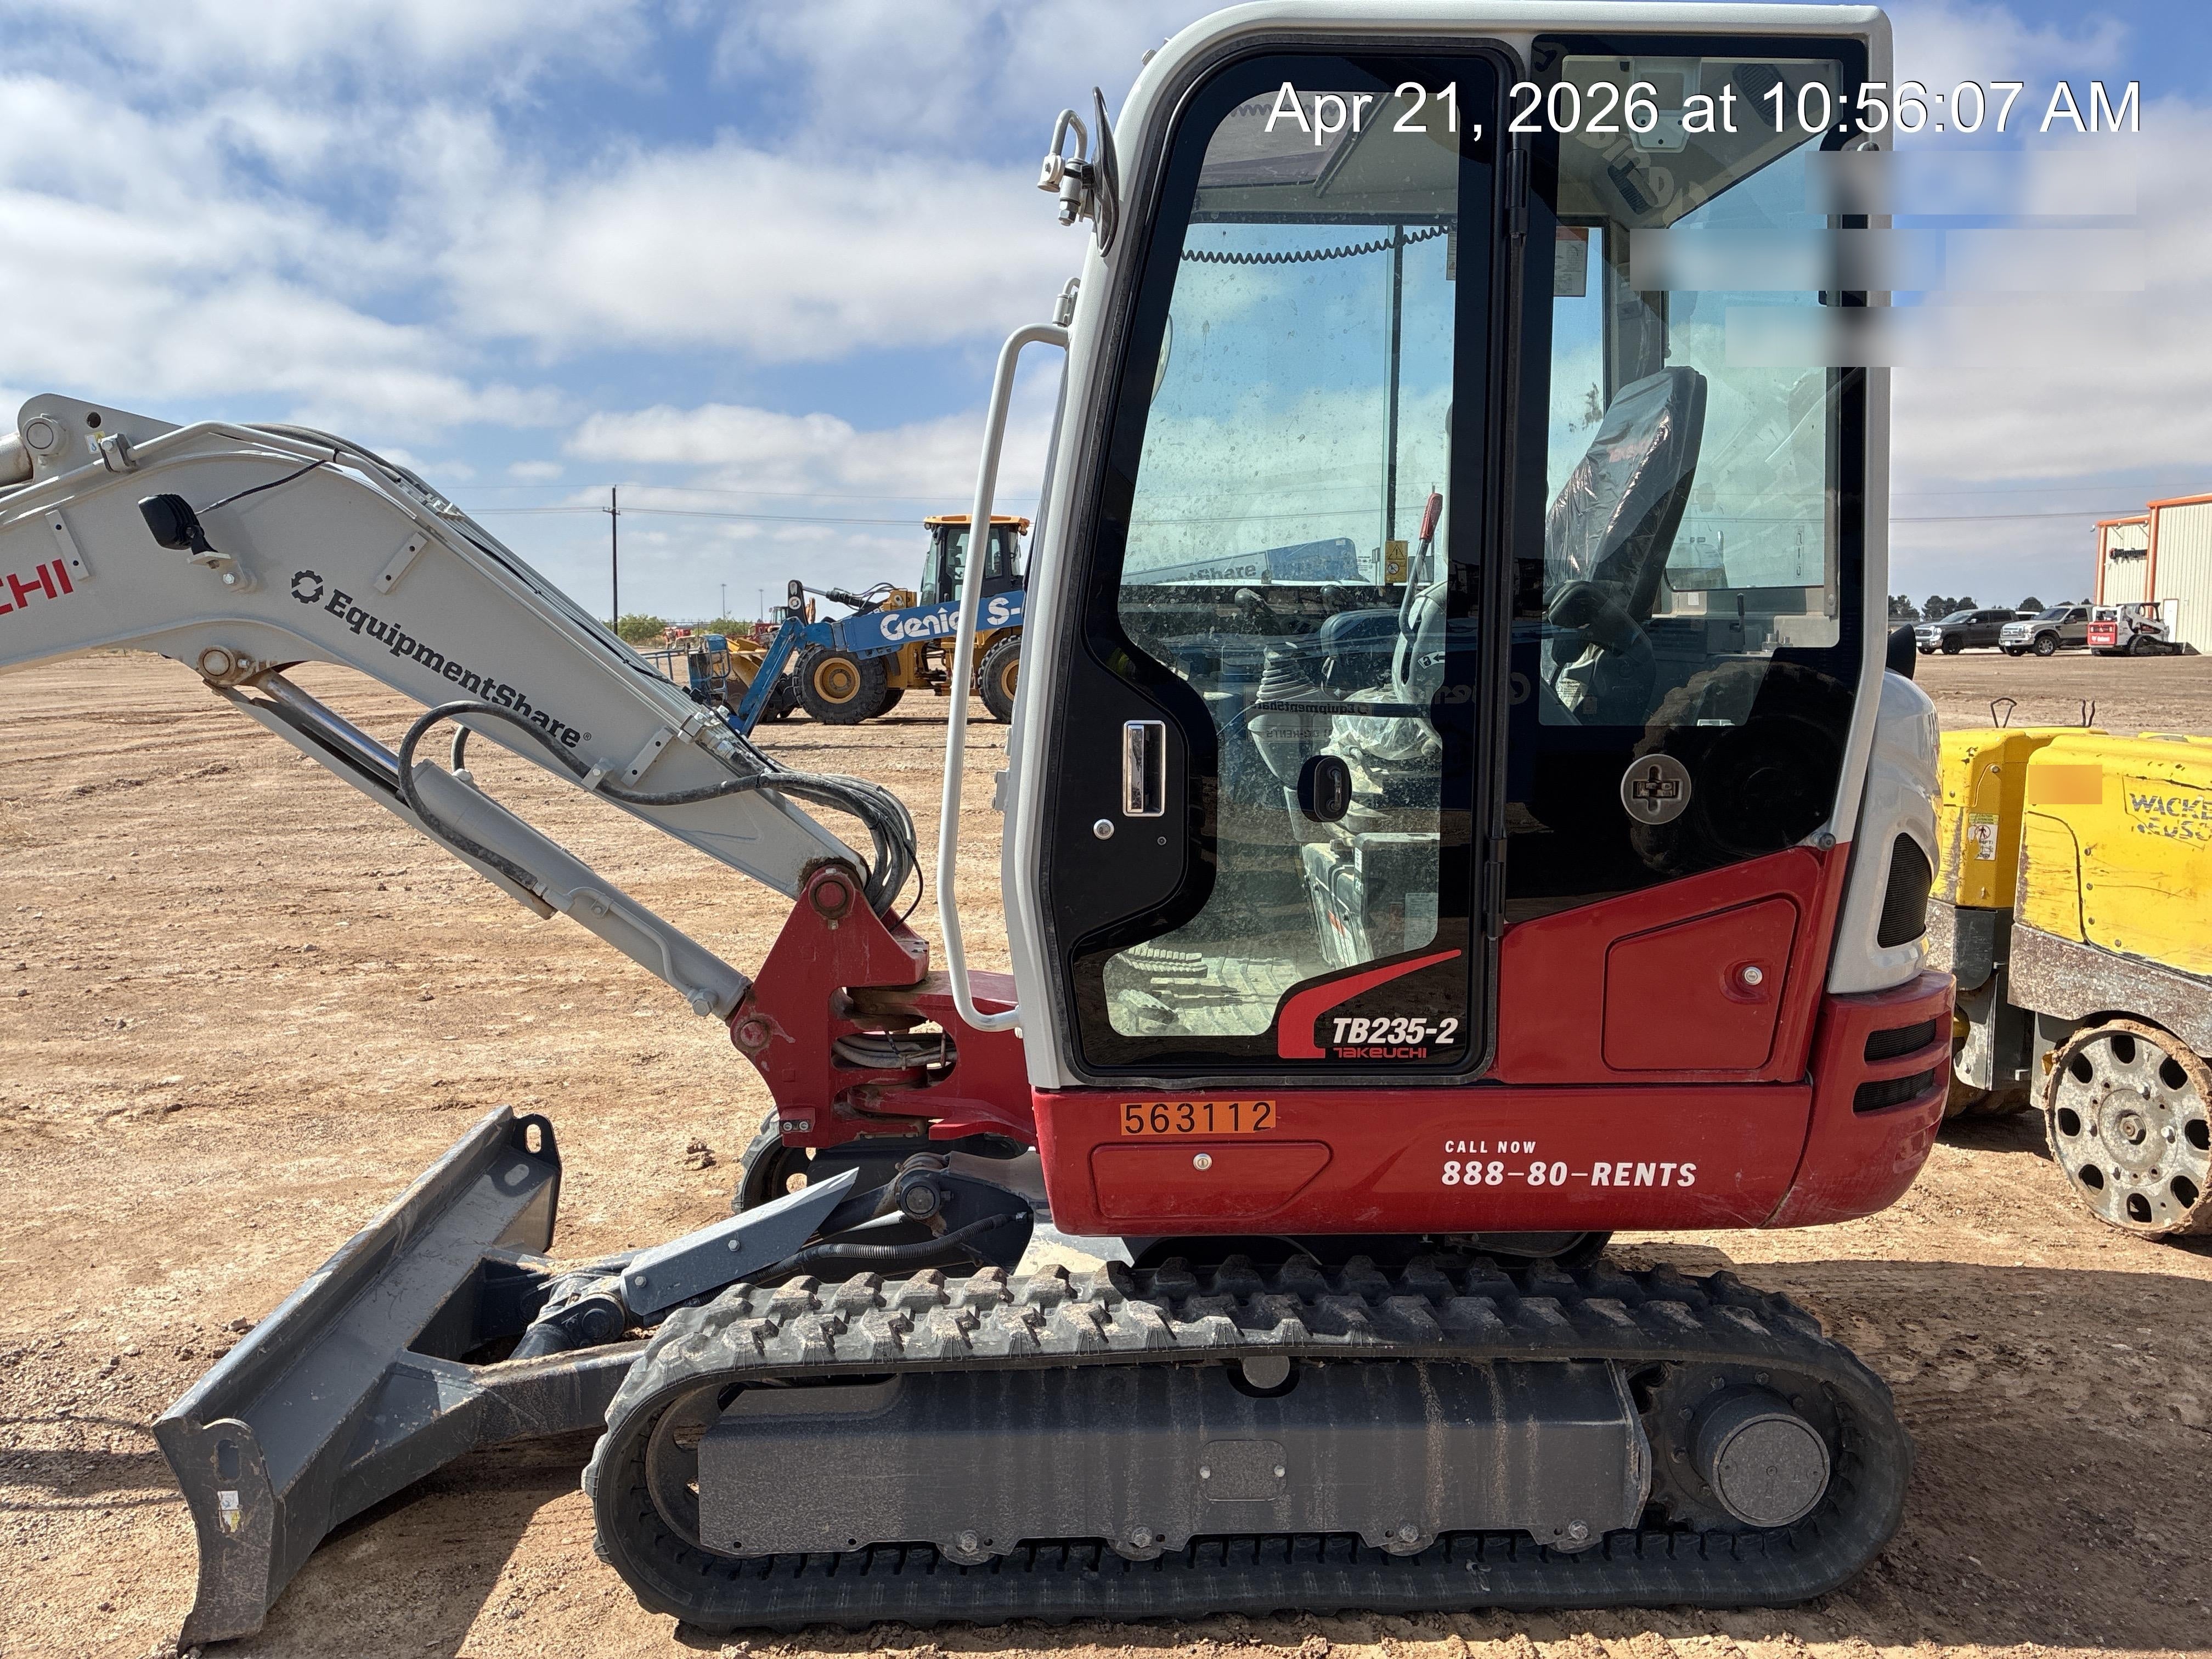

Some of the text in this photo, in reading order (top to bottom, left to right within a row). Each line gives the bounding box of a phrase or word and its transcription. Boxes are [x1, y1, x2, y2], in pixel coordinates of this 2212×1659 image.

[1333, 1017, 1459, 1045] TB235-2
[1333, 1047, 1427, 1058] TAKEUCHI
[1125, 1101, 1271, 1134] 563112
[1444, 1140, 1537, 1154] CALL NOW
[1441, 1160, 1697, 1187] 888-80-RENTS
